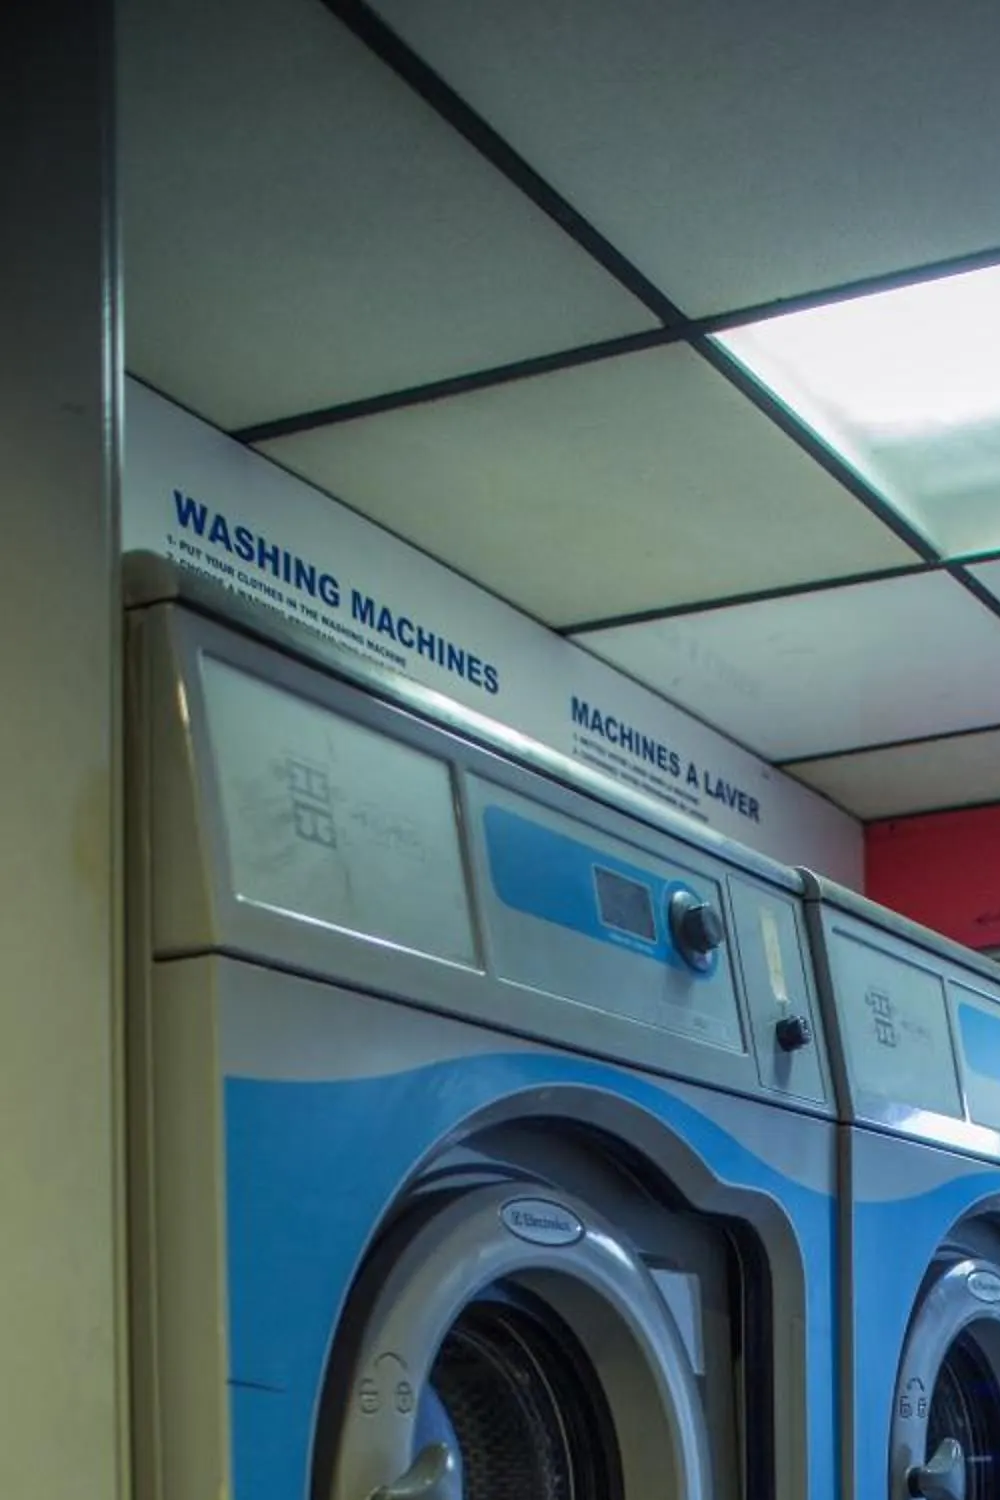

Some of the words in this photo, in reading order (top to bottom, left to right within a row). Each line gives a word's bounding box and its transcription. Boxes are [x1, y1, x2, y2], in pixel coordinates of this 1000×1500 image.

[173, 489, 340, 608] WASHING
[351, 588, 500, 695] MACHINES
[180, 540, 202, 560] PUT
[205, 553, 235, 577] YOUR
[237, 571, 284, 603] CLOTHES
[300, 604, 318, 622] THE
[571, 696, 681, 778] MACHINES
[686, 761, 699, 790] A
[703, 770, 761, 824] LAVER
